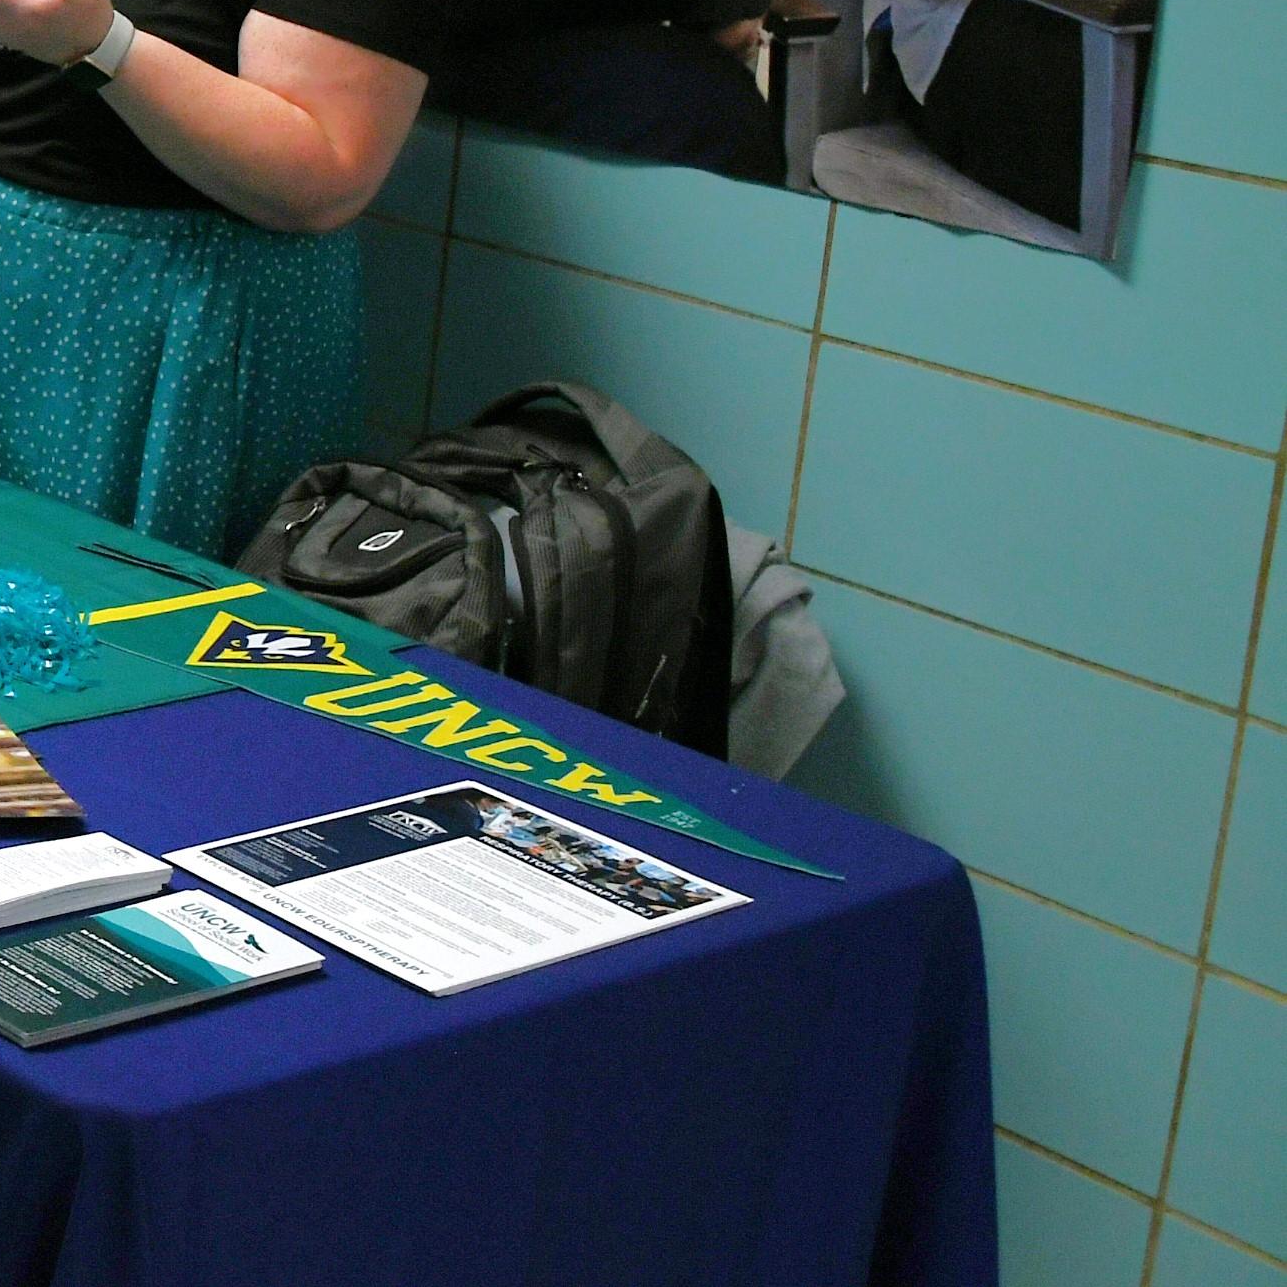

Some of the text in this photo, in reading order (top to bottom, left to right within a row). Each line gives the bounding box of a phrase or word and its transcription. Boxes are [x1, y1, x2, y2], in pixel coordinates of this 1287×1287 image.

[302, 671, 661, 807] UNCW
[475, 835, 567, 875] RESPIRATORY
[558, 873, 623, 900] THERAPY
[165, 907, 201, 926] School
[205, 929, 241, 947] Social
[235, 945, 267, 961] Work
[178, 902, 248, 936] UNCW
[259, 893, 430, 976] UNCW.EDU/RSPTHERAPY
